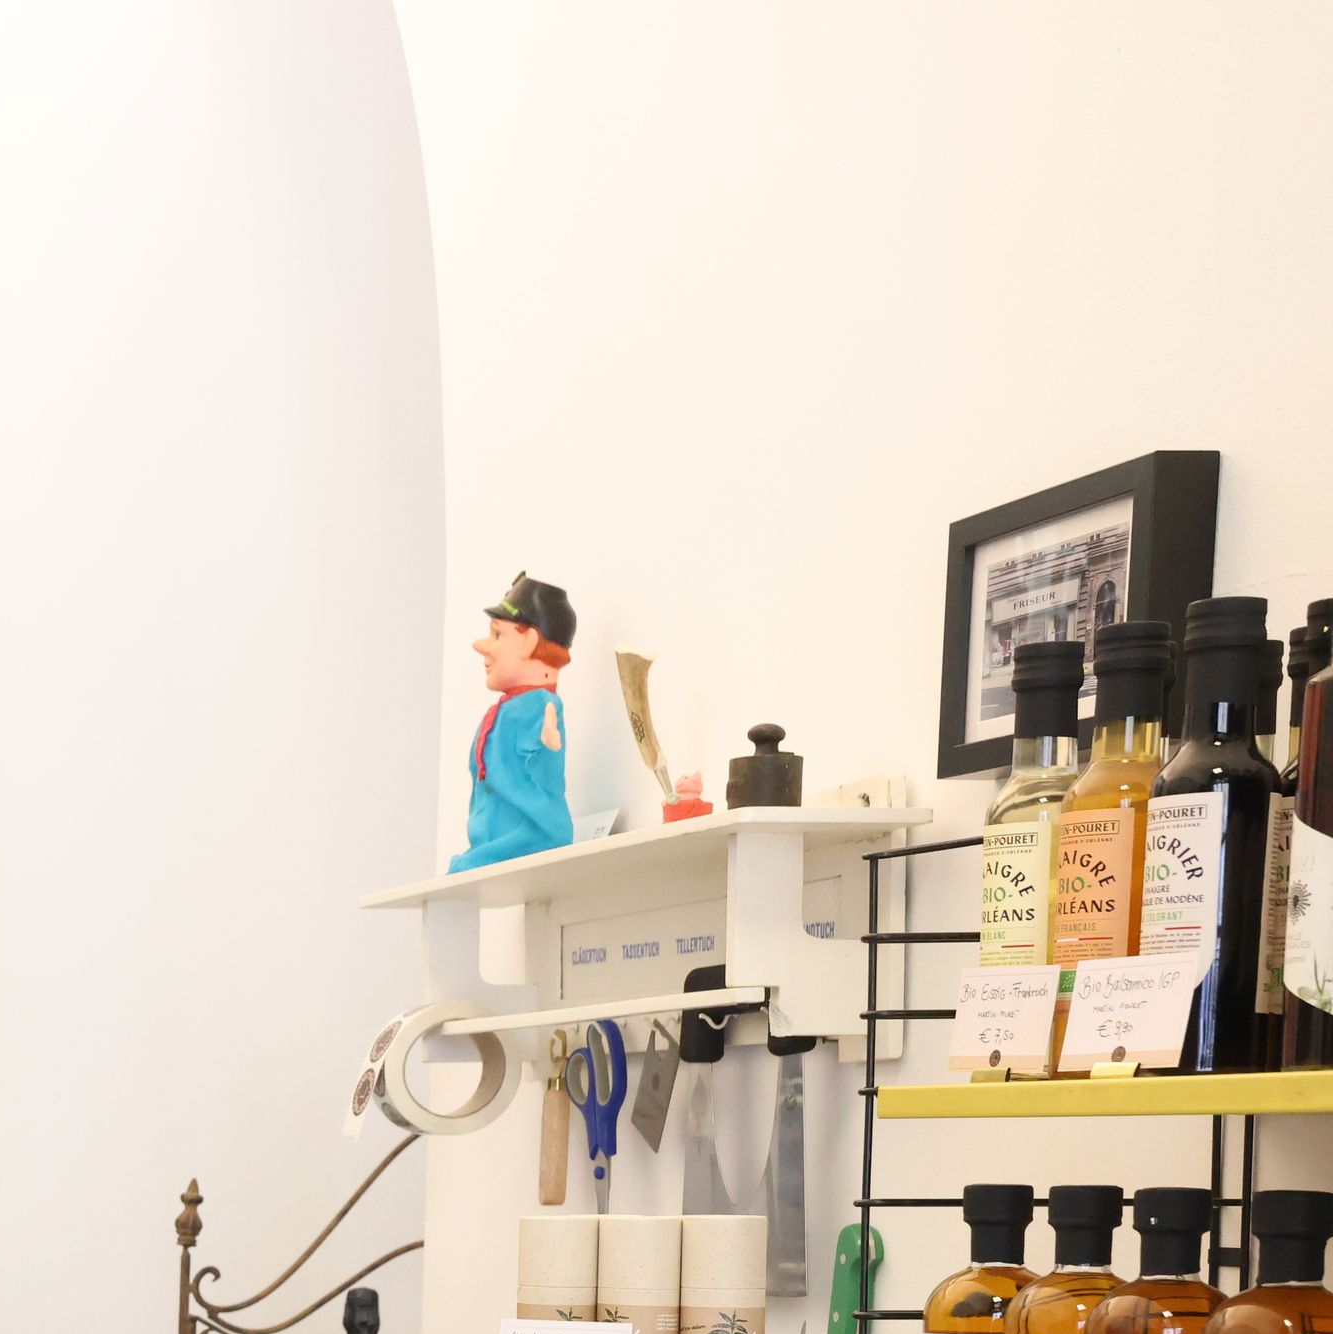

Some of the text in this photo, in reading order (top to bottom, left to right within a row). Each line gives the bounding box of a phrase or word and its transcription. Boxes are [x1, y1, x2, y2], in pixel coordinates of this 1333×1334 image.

[1013, 591, 1056, 611] FRISEUR
[676, 936, 715, 954] TELLERTUCH
[1159, 971, 1180, 989] IGP
